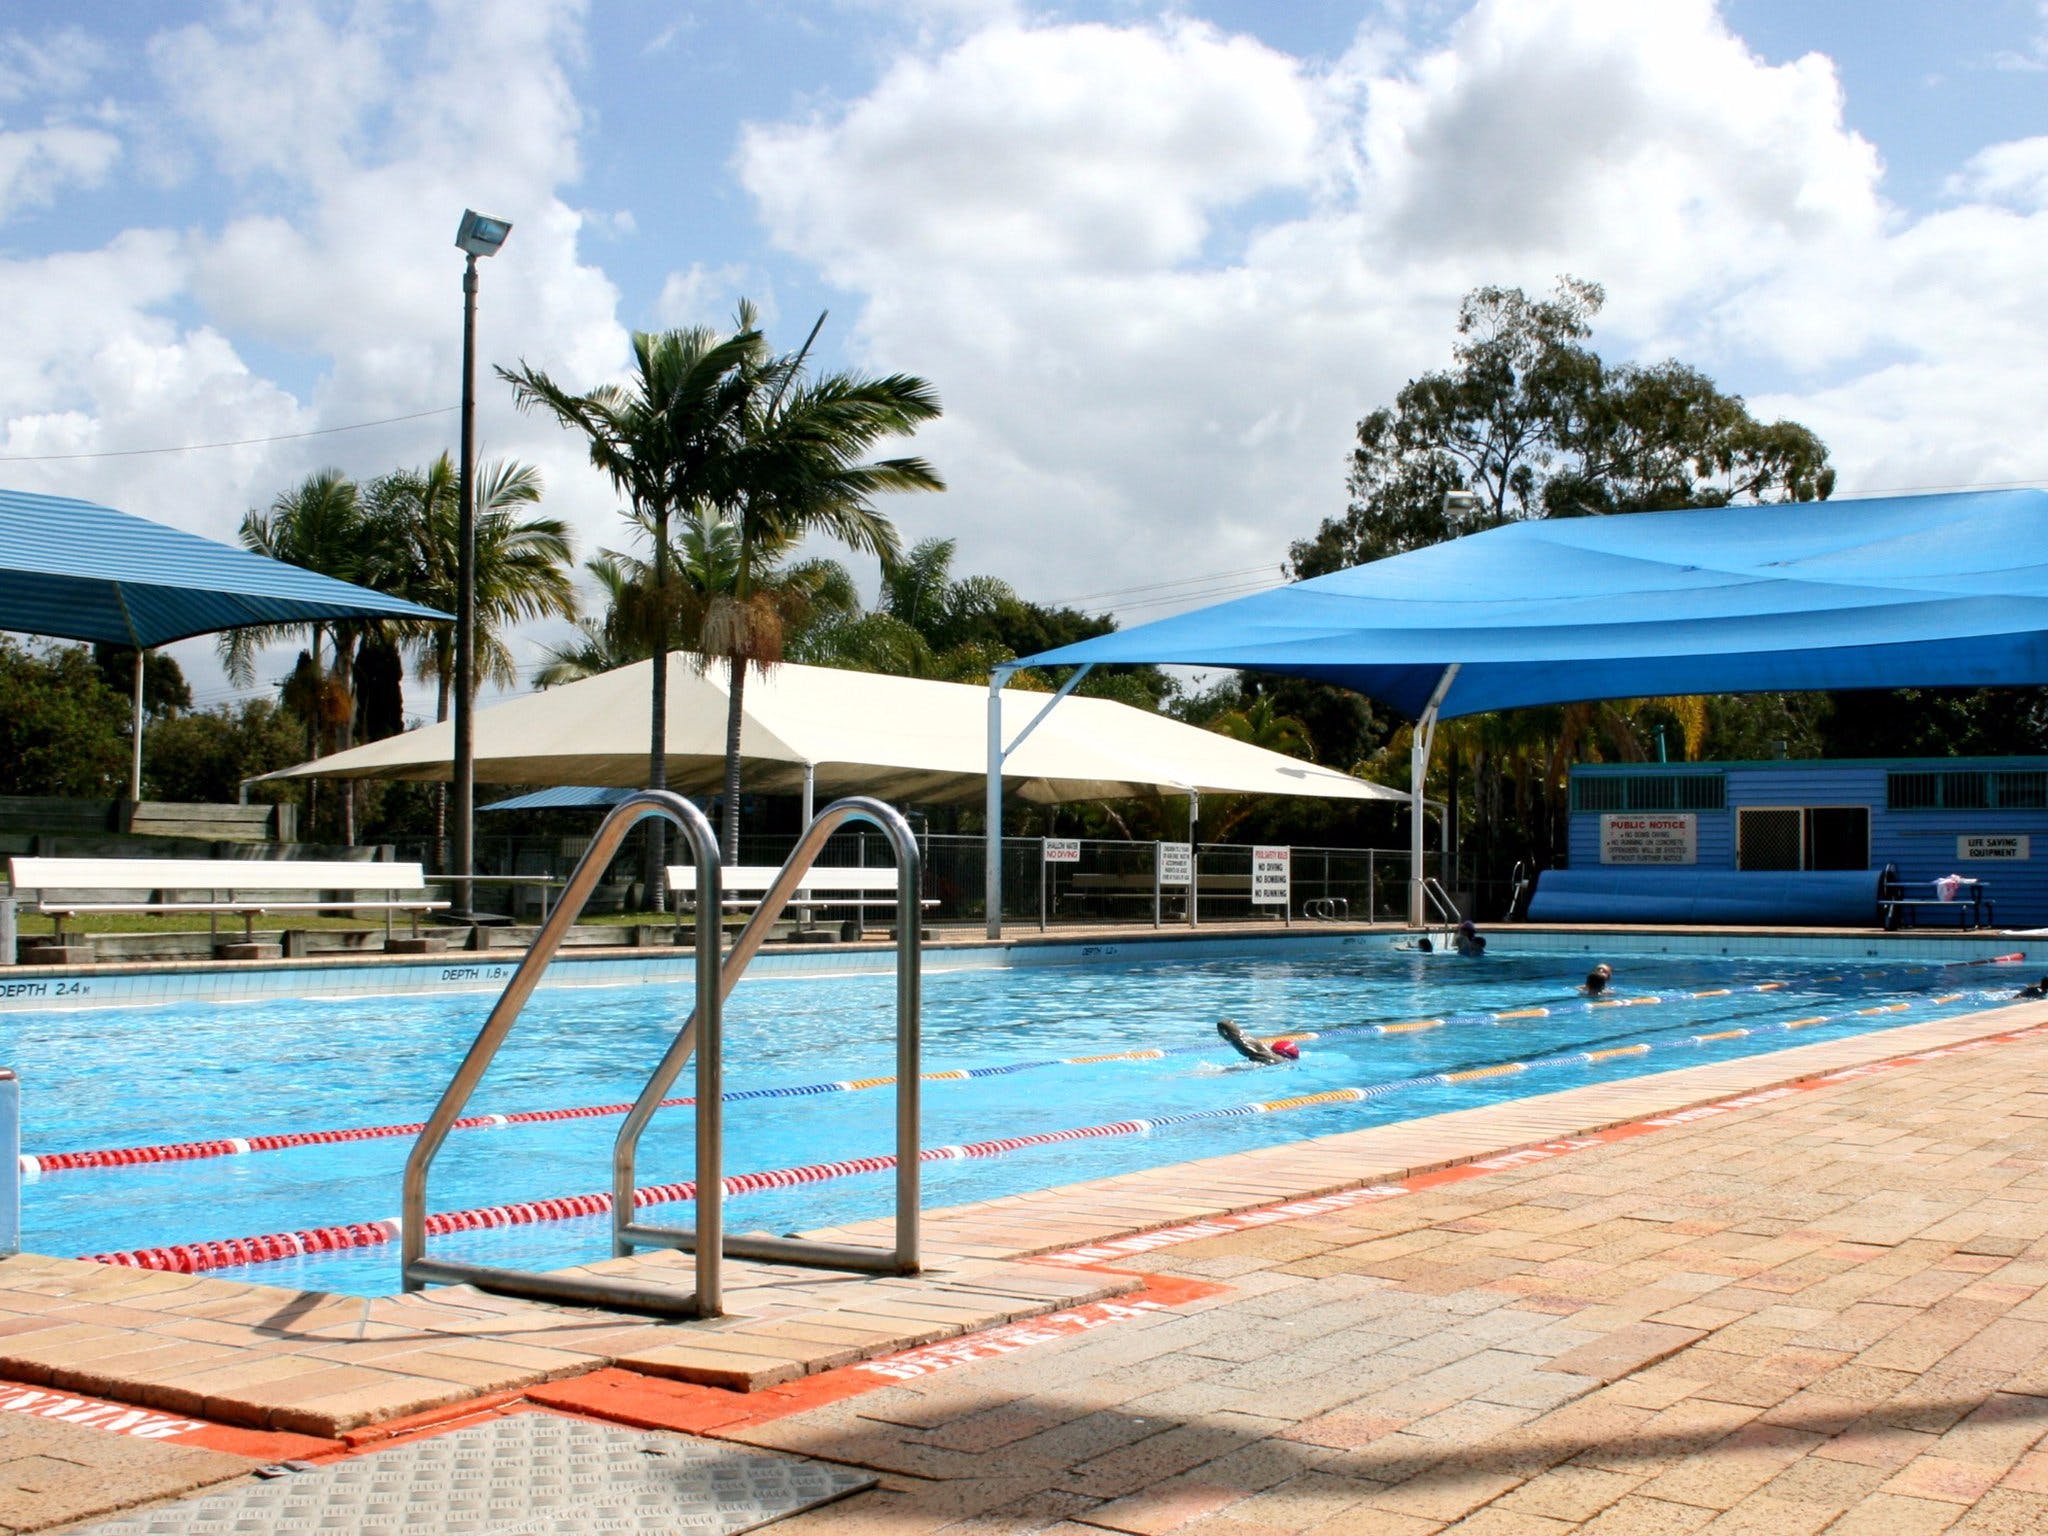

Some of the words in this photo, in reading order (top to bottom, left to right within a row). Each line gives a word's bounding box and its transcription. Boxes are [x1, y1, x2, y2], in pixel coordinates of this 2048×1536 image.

[1610, 821, 1646, 830] PUBLIC
[1648, 821, 1686, 830] NOTICE
[1968, 838, 1984, 846] LIFE
[1986, 838, 2018, 846] SAVING
[1046, 850, 1056, 858] NO
[1058, 850, 1078, 858] DIVING
[1969, 848, 2017, 857] EQUIPMENT
[1258, 862, 1266, 871] NO
[1266, 862, 1283, 871] DIVING
[1256, 875, 1262, 884] NO
[1264, 875, 1286, 884] BOMBING
[1254, 889, 1262, 898] NO
[1264, 889, 1287, 898] RUNNING
[441, 968, 480, 980] DEPTH
[0, 983, 47, 998] DEPTH
